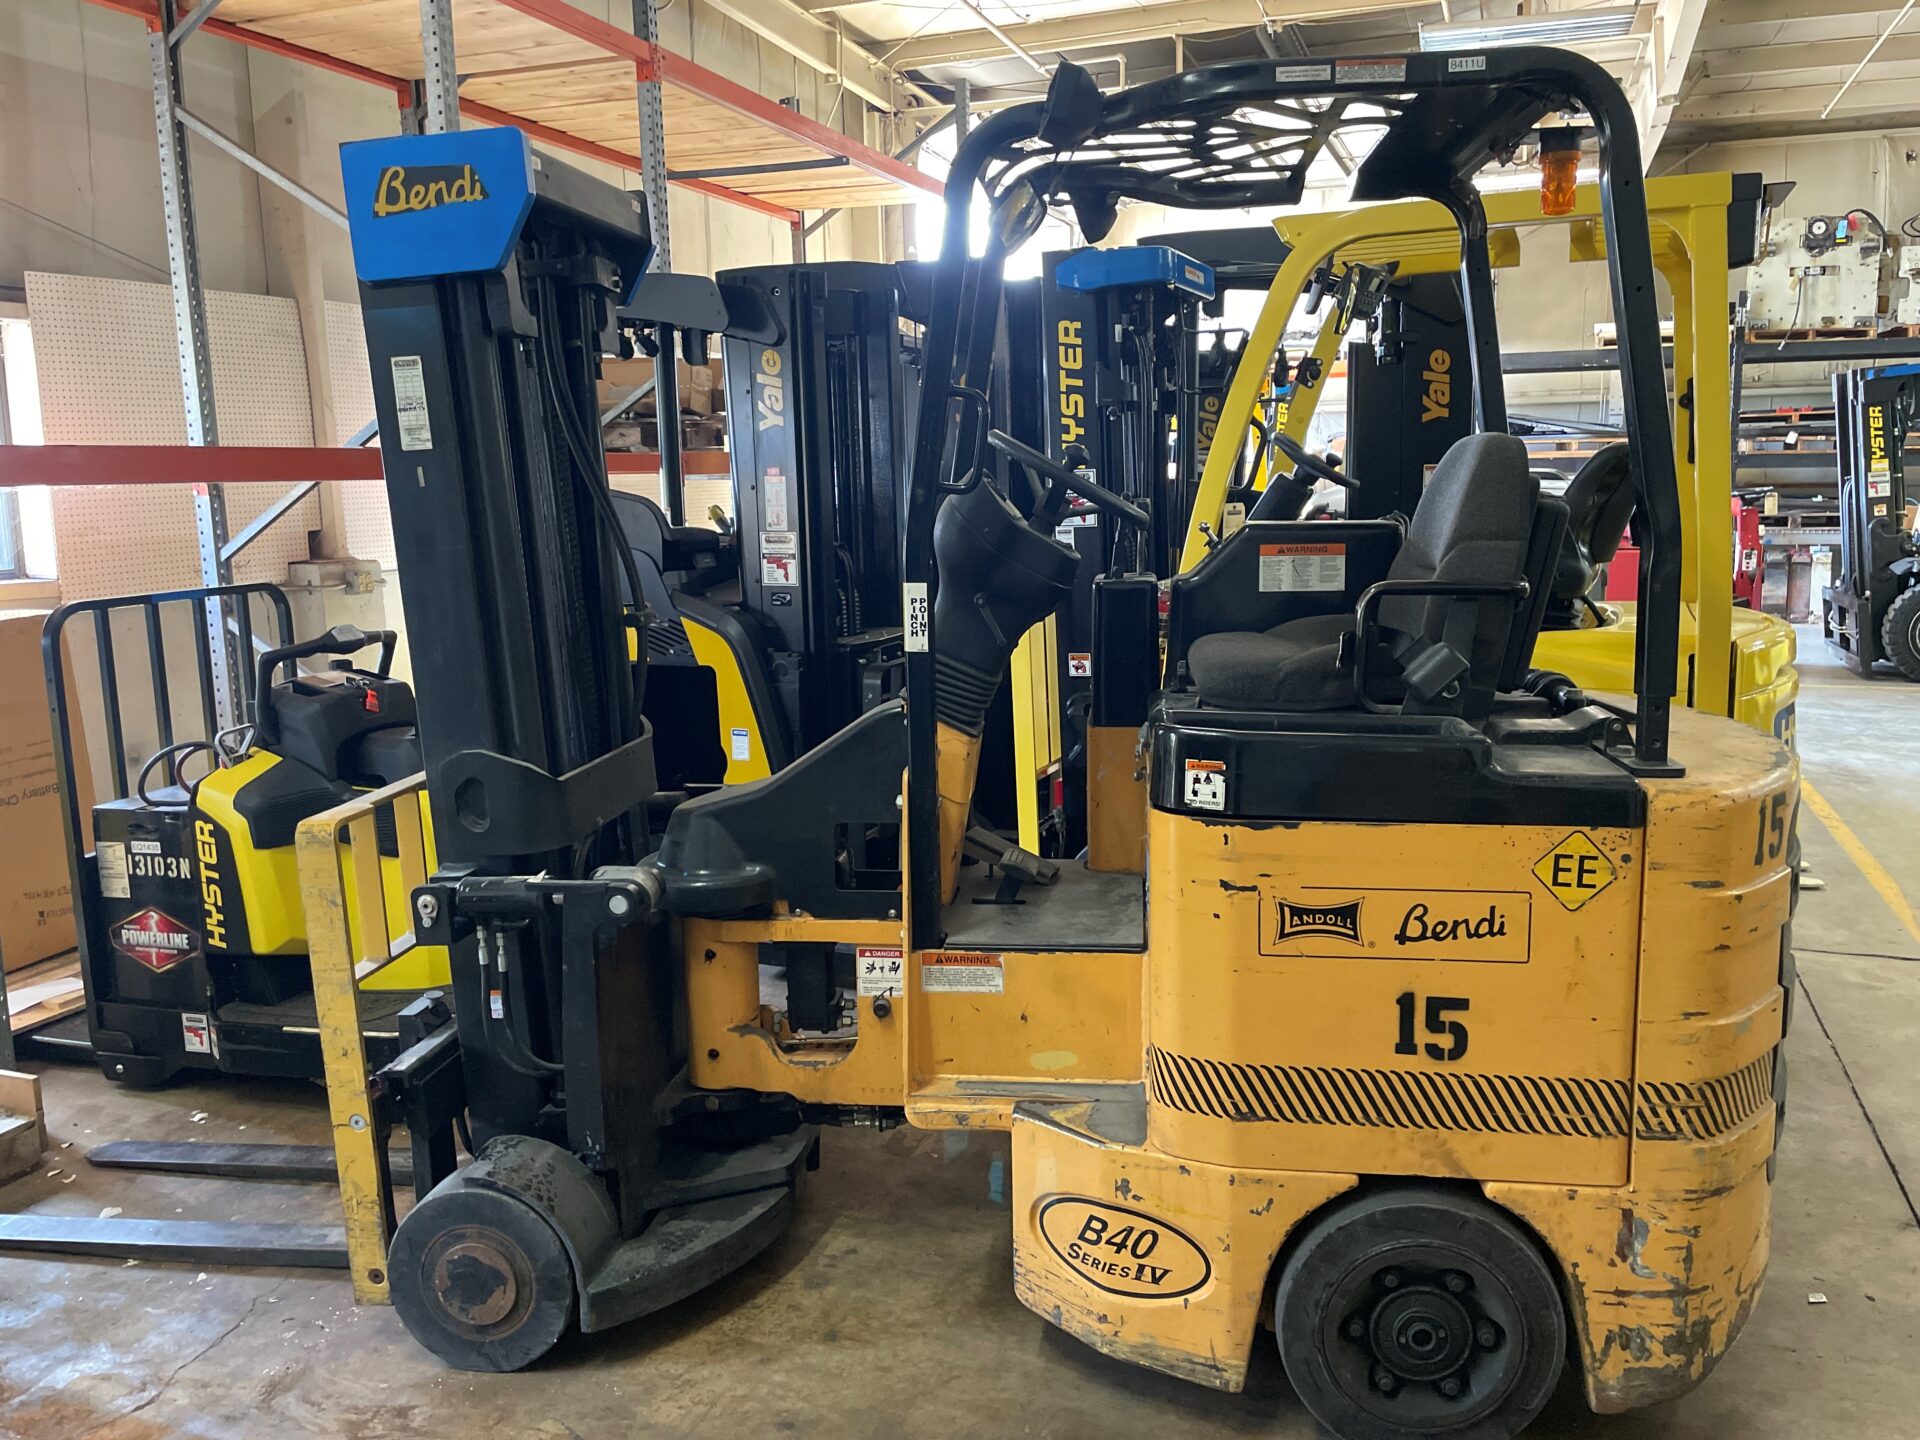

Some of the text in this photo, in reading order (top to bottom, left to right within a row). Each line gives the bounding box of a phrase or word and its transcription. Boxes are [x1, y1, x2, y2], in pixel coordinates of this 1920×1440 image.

[1450, 58, 1484, 70] 8411U
[374, 164, 484, 217] Bendi
[756, 349, 785, 431] Yale
[1058, 319, 1086, 469] YSTER
[1422, 349, 1451, 423] Yale
[1197, 396, 1219, 449] Yale
[1286, 545, 1328, 553] WARNING
[910, 598, 919, 637] PINCH
[919, 598, 927, 637] POINT
[22, 782, 60, 799] Battery
[132, 843, 160, 852] EQ1435
[1754, 791, 1787, 867] 15
[127, 854, 191, 879] 13103N
[195, 819, 228, 949] HYSTER
[1551, 853, 1599, 889] EE
[121, 929, 190, 949] POWERLINE
[1284, 903, 1507, 946] LANDOLL Bendi
[944, 956, 990, 965] WARNING
[1395, 992, 1469, 1061] 15
[1077, 1214, 1160, 1260] B40
[1131, 1262, 1174, 1286] IV
